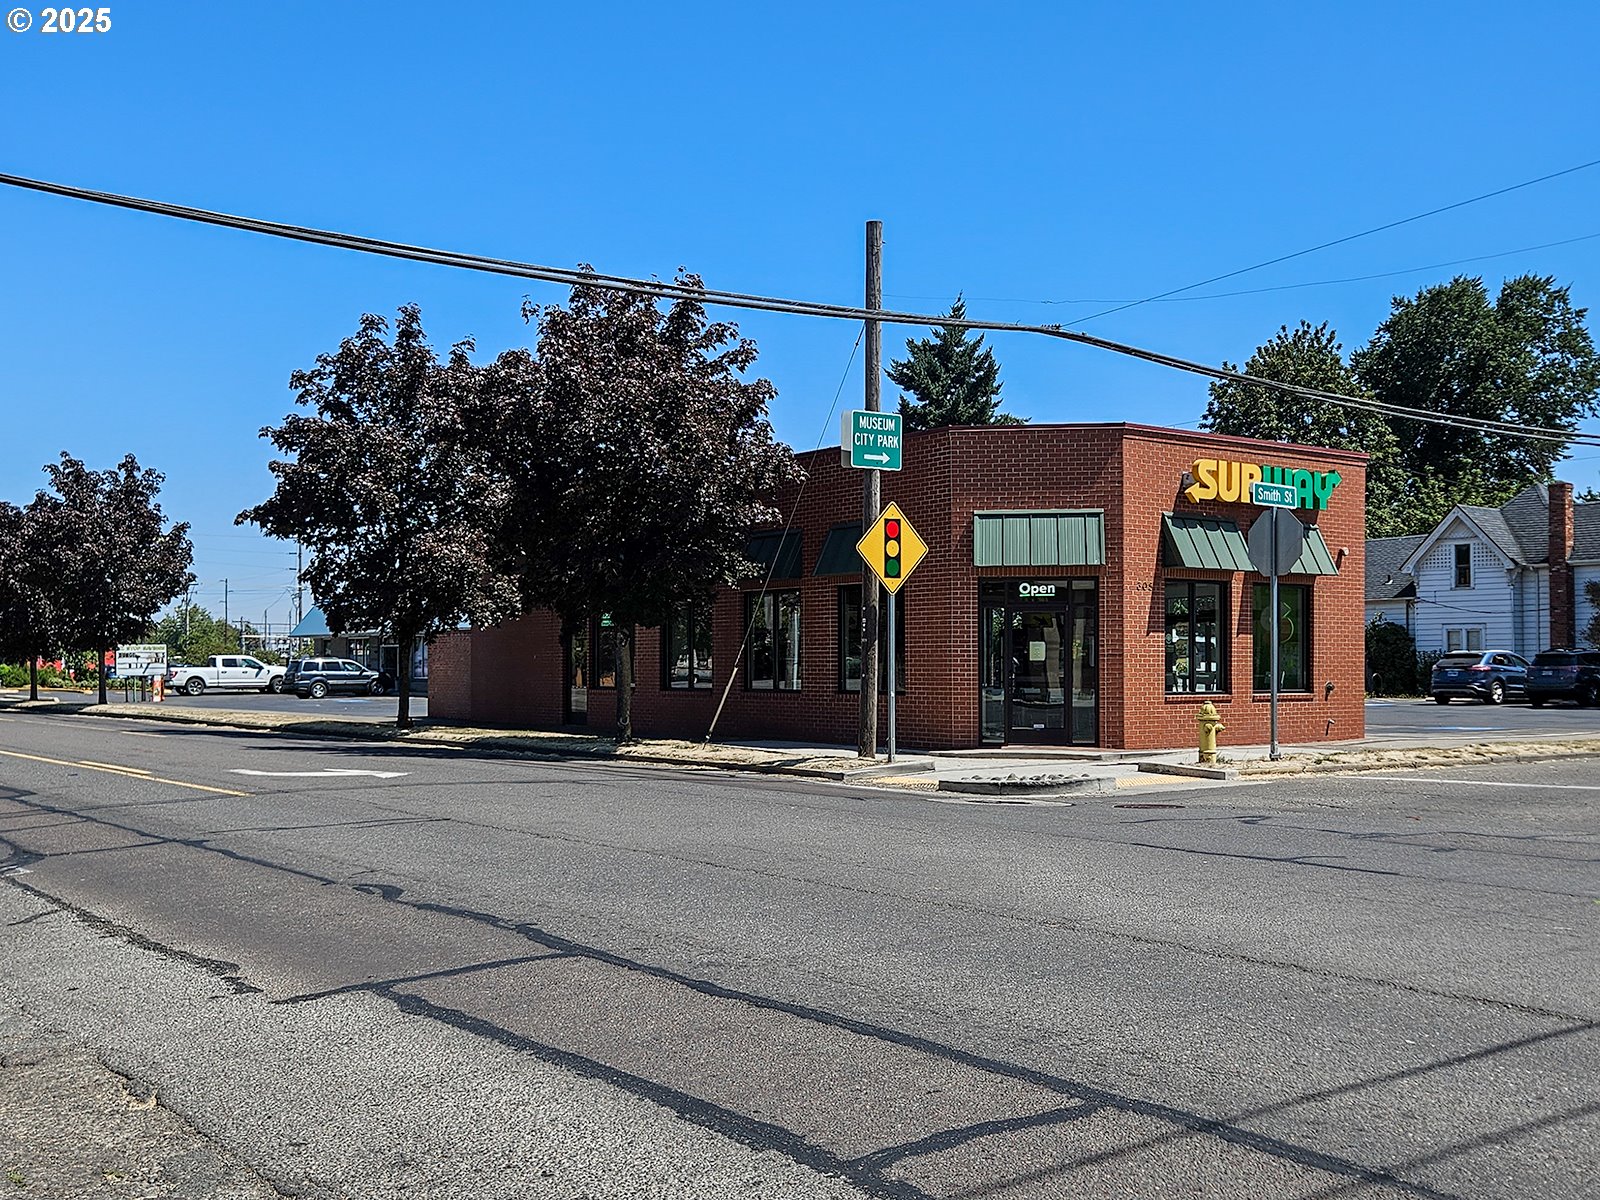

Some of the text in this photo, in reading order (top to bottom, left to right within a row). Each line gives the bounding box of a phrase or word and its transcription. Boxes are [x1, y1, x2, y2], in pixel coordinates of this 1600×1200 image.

[859, 415, 896, 432] MUSEUM
[854, 432, 899, 449] CITY PARK
[1257, 486, 1293, 504] Smith St
[1019, 582, 1056, 597] Open
